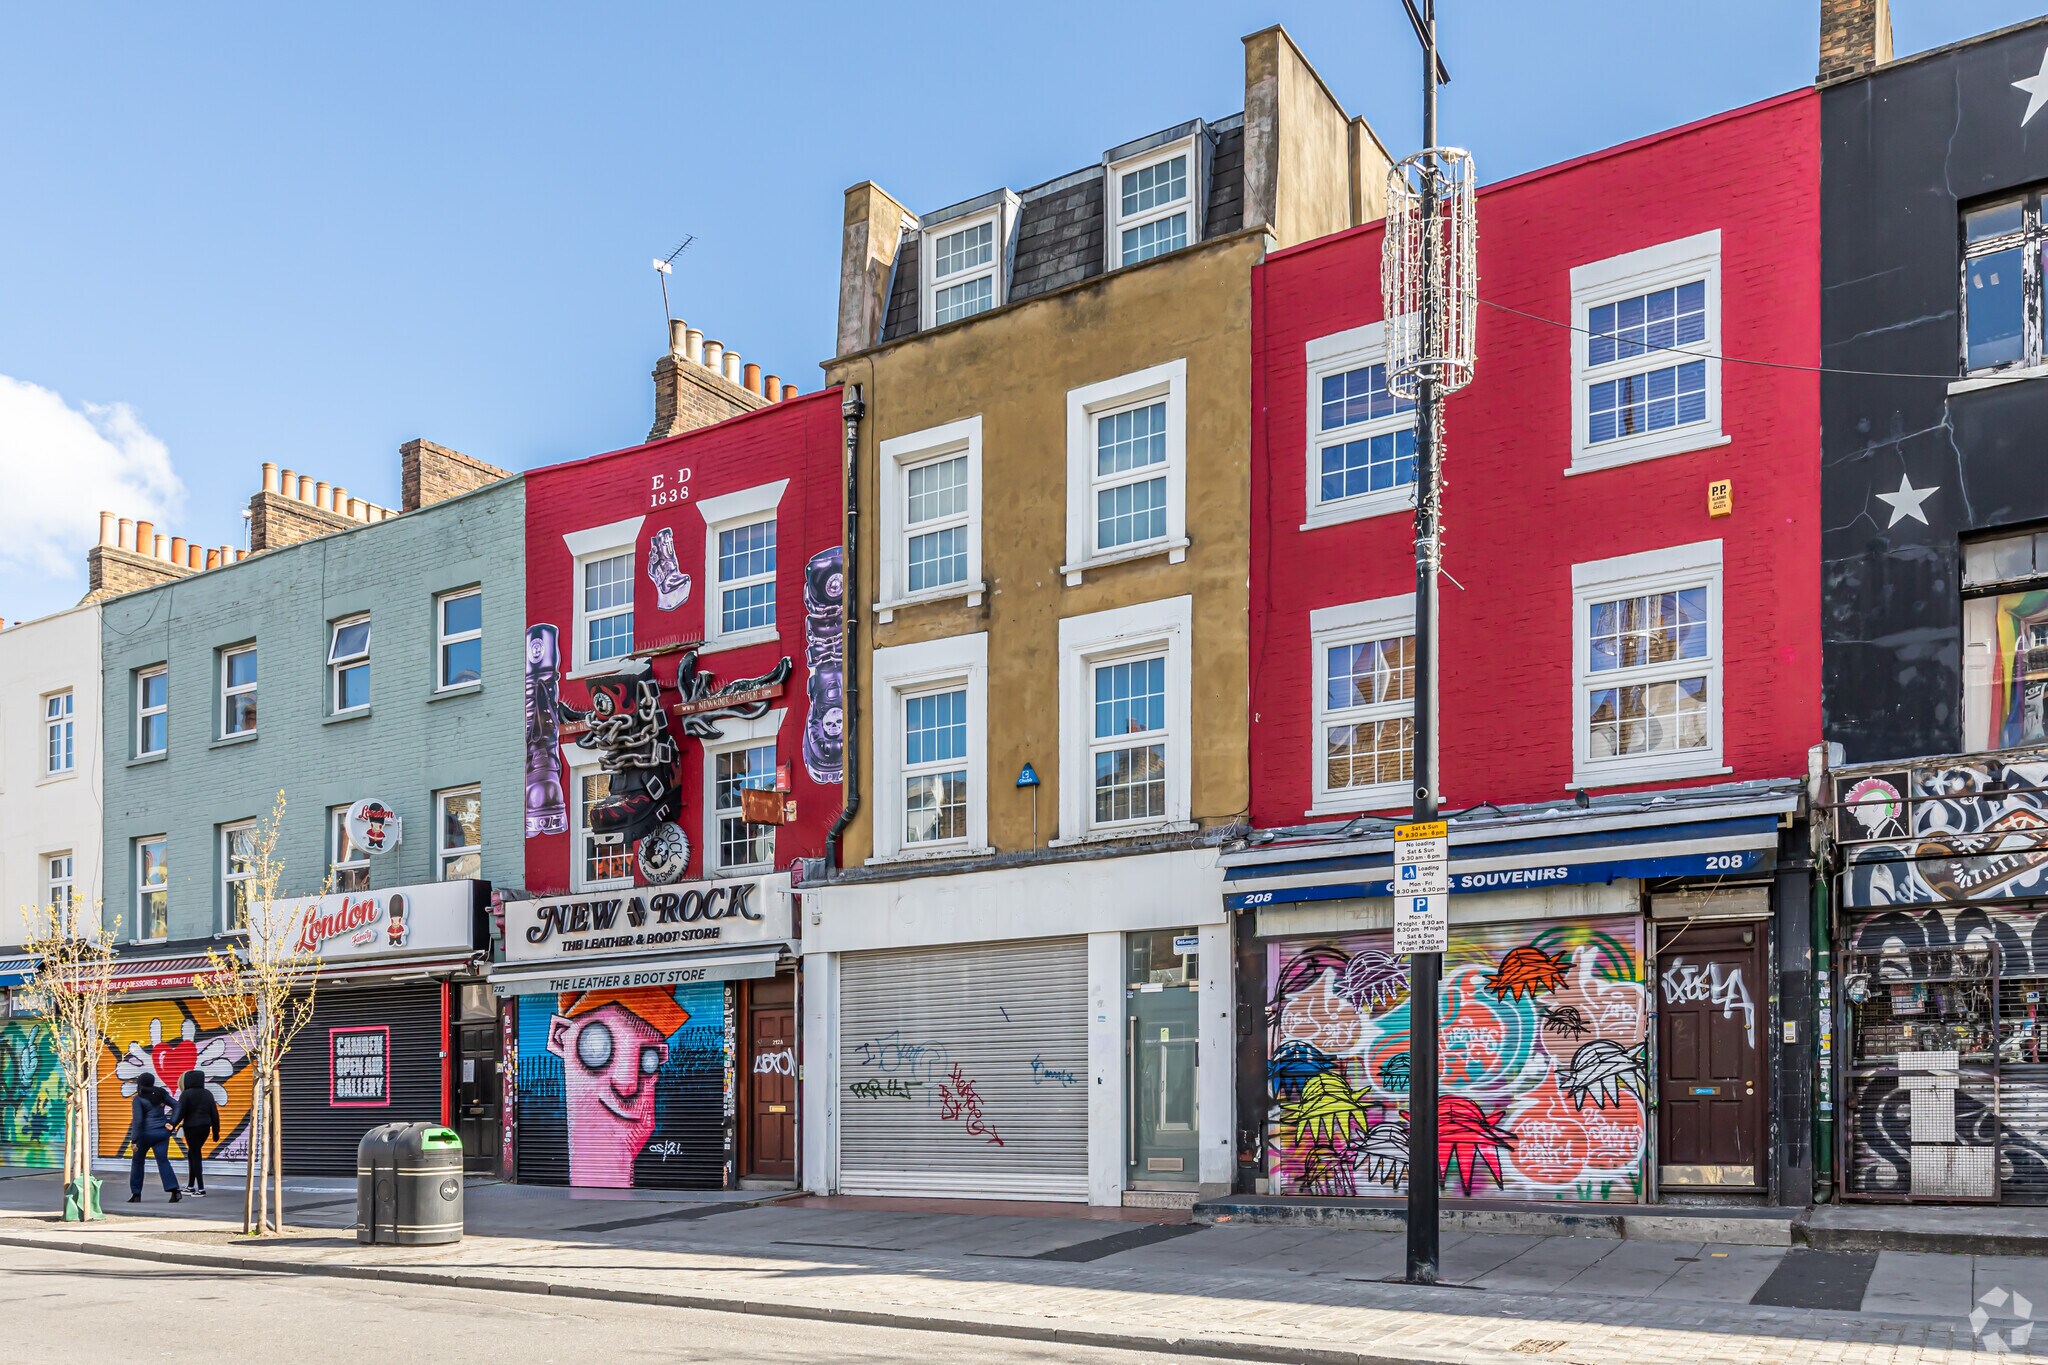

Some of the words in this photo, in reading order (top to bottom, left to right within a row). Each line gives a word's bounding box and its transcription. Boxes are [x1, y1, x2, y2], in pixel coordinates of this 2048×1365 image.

[651, 486, 689, 507] 1838
[358, 805, 394, 820] London
[1705, 855, 1743, 869] 208
[661, 864, 677, 882] Shoes
[1461, 867, 1568, 888] SOUVENIRS
[1244, 892, 1273, 904] 208
[1417, 899, 1426, 911] P
[526, 899, 621, 943] NEW
[650, 883, 761, 923] ROCK
[294, 896, 378, 952] London
[351, 929, 372, 944] Family
[562, 940, 583, 951] THE
[584, 936, 633, 950] LEATHER
[635, 934, 645, 945] &
[646, 931, 680, 944] BOOT
[681, 927, 720, 940] STORE
[162, 974, 187, 986] CONTACT
[550, 979, 570, 990] THE
[572, 975, 620, 989] LEATHER
[623, 974, 630, 985] &
[634, 972, 666, 984] BOOT
[667, 969, 706, 982] STORE
[336, 1036, 383, 1056] CAMDEN
[336, 1056, 364, 1076] OPEN
[365, 1056, 383, 1076] AIR
[336, 1078, 384, 1097] GALLERY
